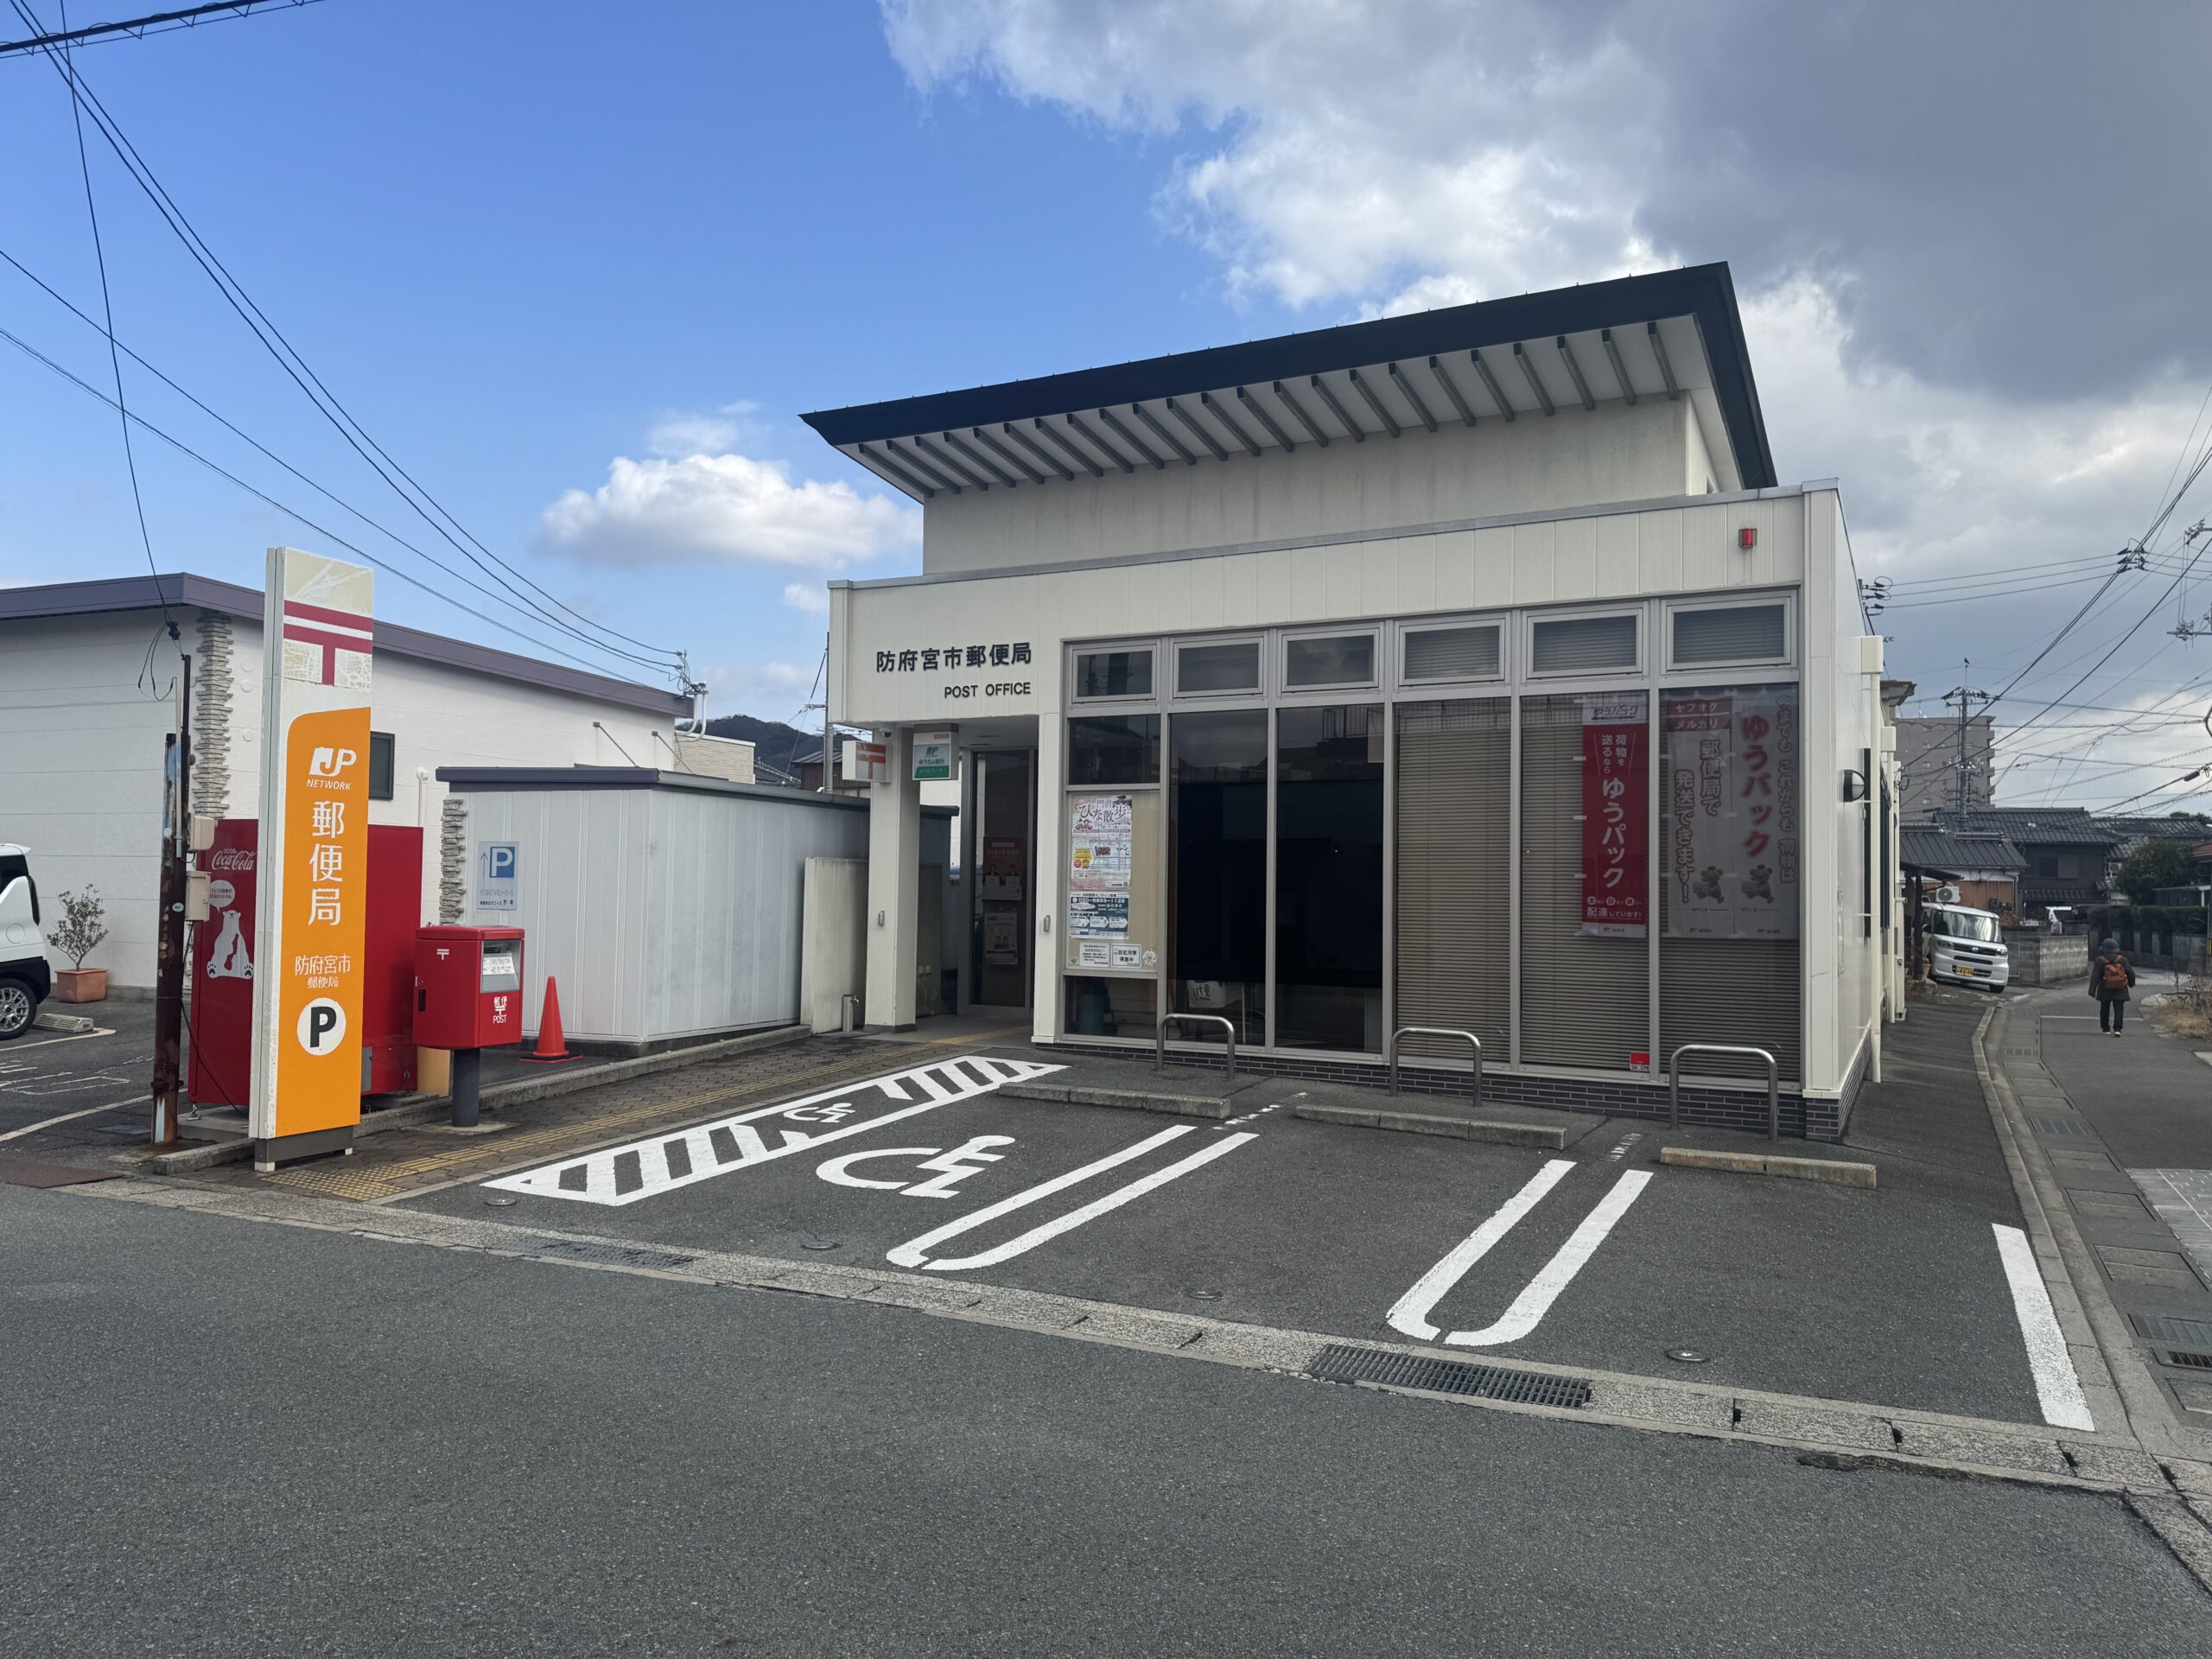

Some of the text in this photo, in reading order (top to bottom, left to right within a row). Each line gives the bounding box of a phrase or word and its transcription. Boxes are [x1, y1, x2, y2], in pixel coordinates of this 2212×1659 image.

[876, 642, 1032, 673] 防府宮市郵便局
[944, 682, 1031, 698] POST OFFICE
[1675, 702, 1718, 713] ヤフオク
[1675, 718, 1718, 730] メルカリ
[309, 747, 357, 777] JP
[1602, 734, 1613, 774] 送るなら
[1615, 734, 1627, 766] 荷物を
[306, 779, 352, 791] NETWORK
[1700, 739, 1721, 817] 郵便局で
[1741, 715, 1771, 858] ゆうパック
[1602, 778, 1626, 888] ゆうパック
[1674, 768, 1694, 904] 発送できます!
[212, 850, 257, 871] Coca-Cola
[308, 801, 345, 926] 郵便局
[491, 848, 513, 876] P
[295, 954, 352, 976] 防府宮市
[307, 976, 339, 988] 郵便局
[309, 1007, 337, 1047] P
[493, 1014, 507, 1023] POST
